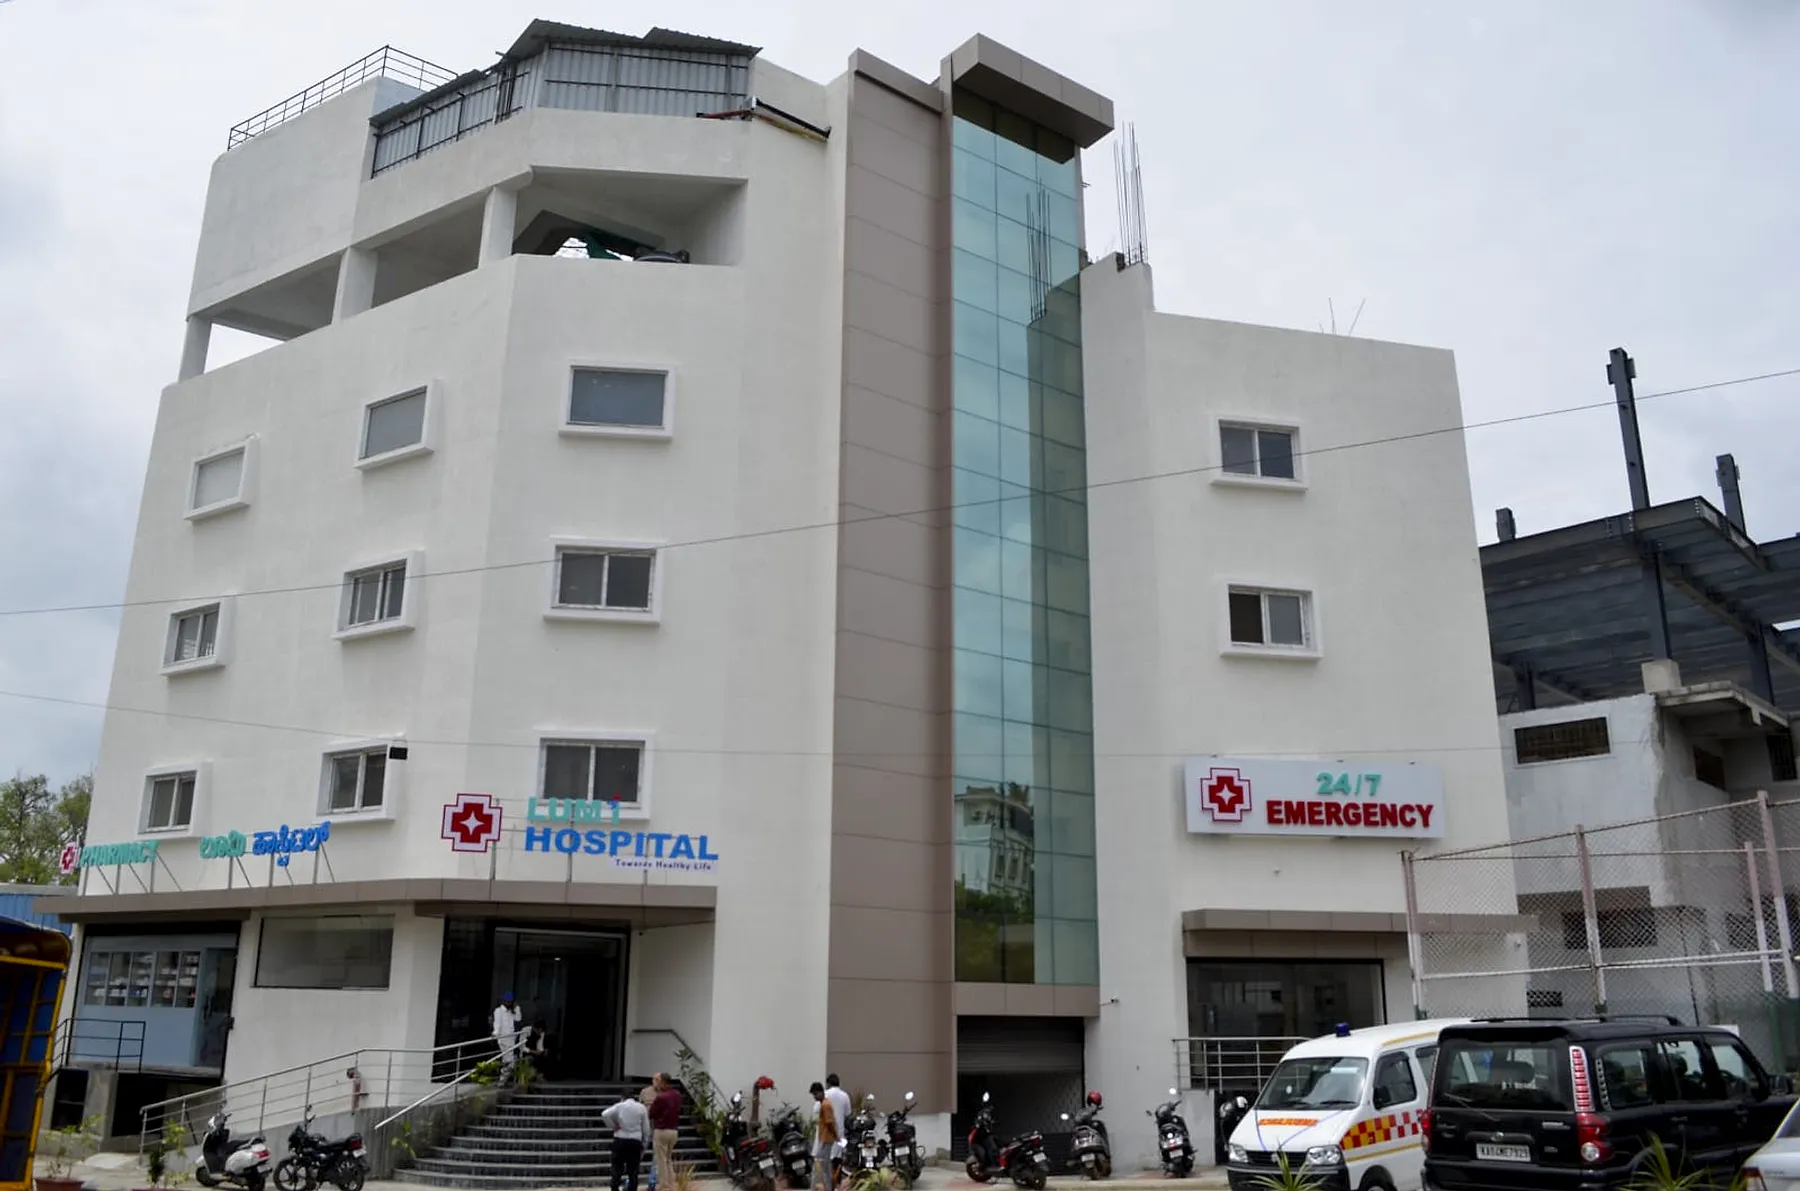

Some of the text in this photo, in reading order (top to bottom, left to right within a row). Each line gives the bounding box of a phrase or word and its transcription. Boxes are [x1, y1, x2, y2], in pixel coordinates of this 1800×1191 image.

[1315, 771, 1382, 797] 24/7
[1266, 799, 1434, 828] EMERGENCY
[80, 840, 160, 868] PHARMACY
[525, 826, 719, 861] HOSPITAL
[615, 858, 712, 871] Towards Healthy Life
